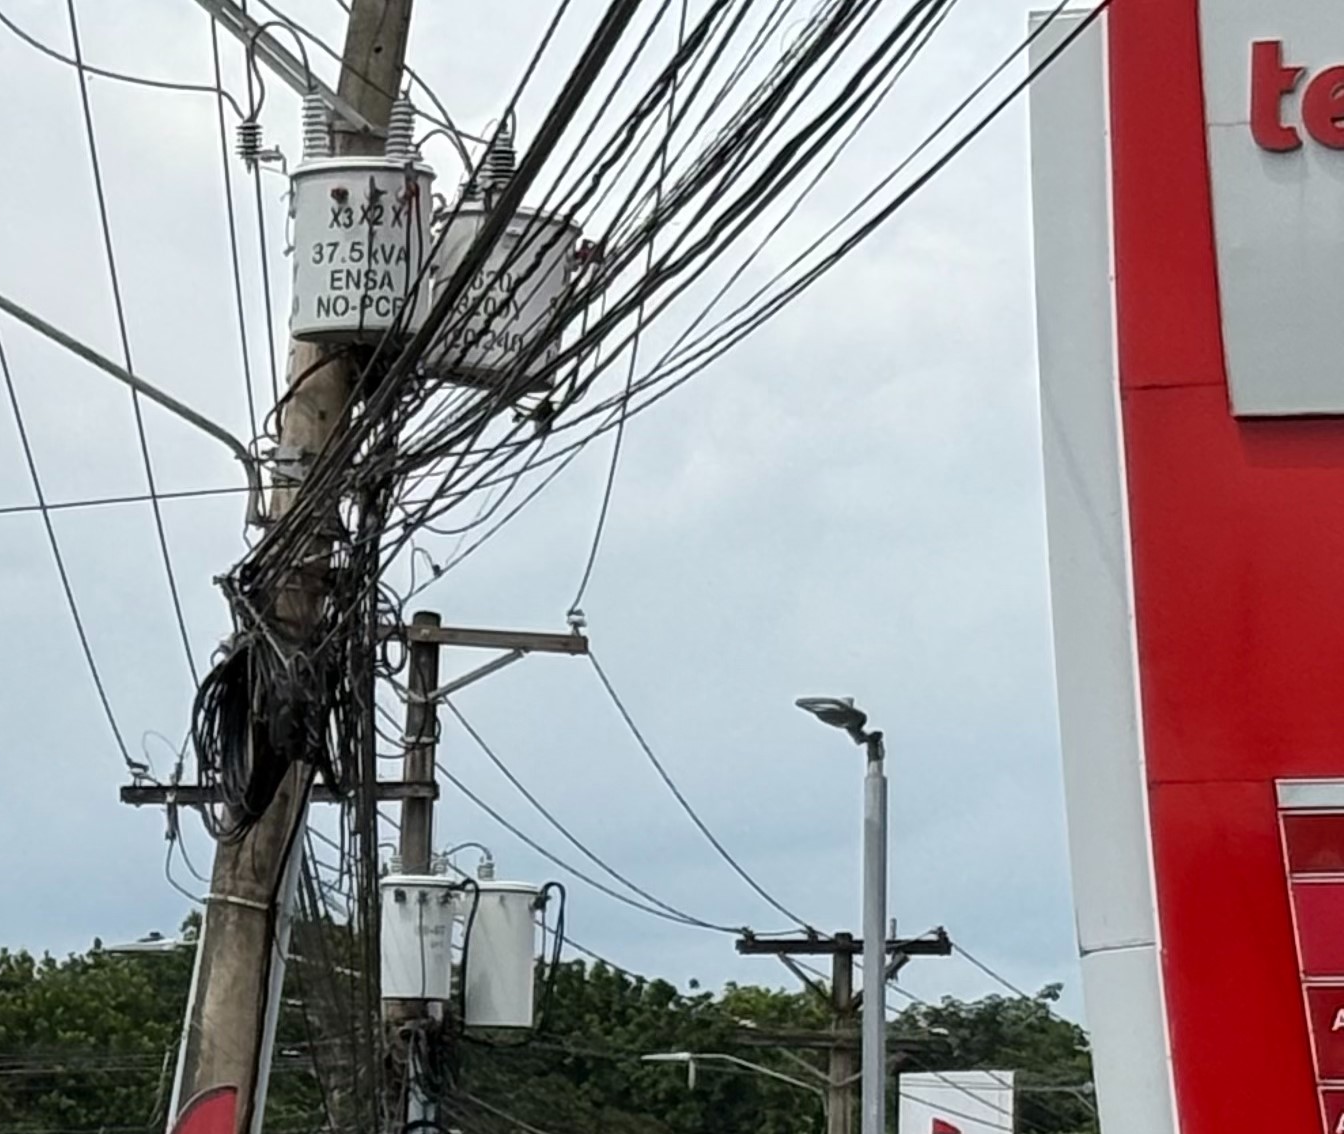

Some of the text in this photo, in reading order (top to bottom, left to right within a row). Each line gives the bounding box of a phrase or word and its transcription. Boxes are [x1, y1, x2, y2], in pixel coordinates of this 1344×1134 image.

[328, 206, 354, 229] X3
[358, 203, 385, 227] X2
[312, 241, 365, 265] 37.5
[330, 268, 394, 292] ENSA
